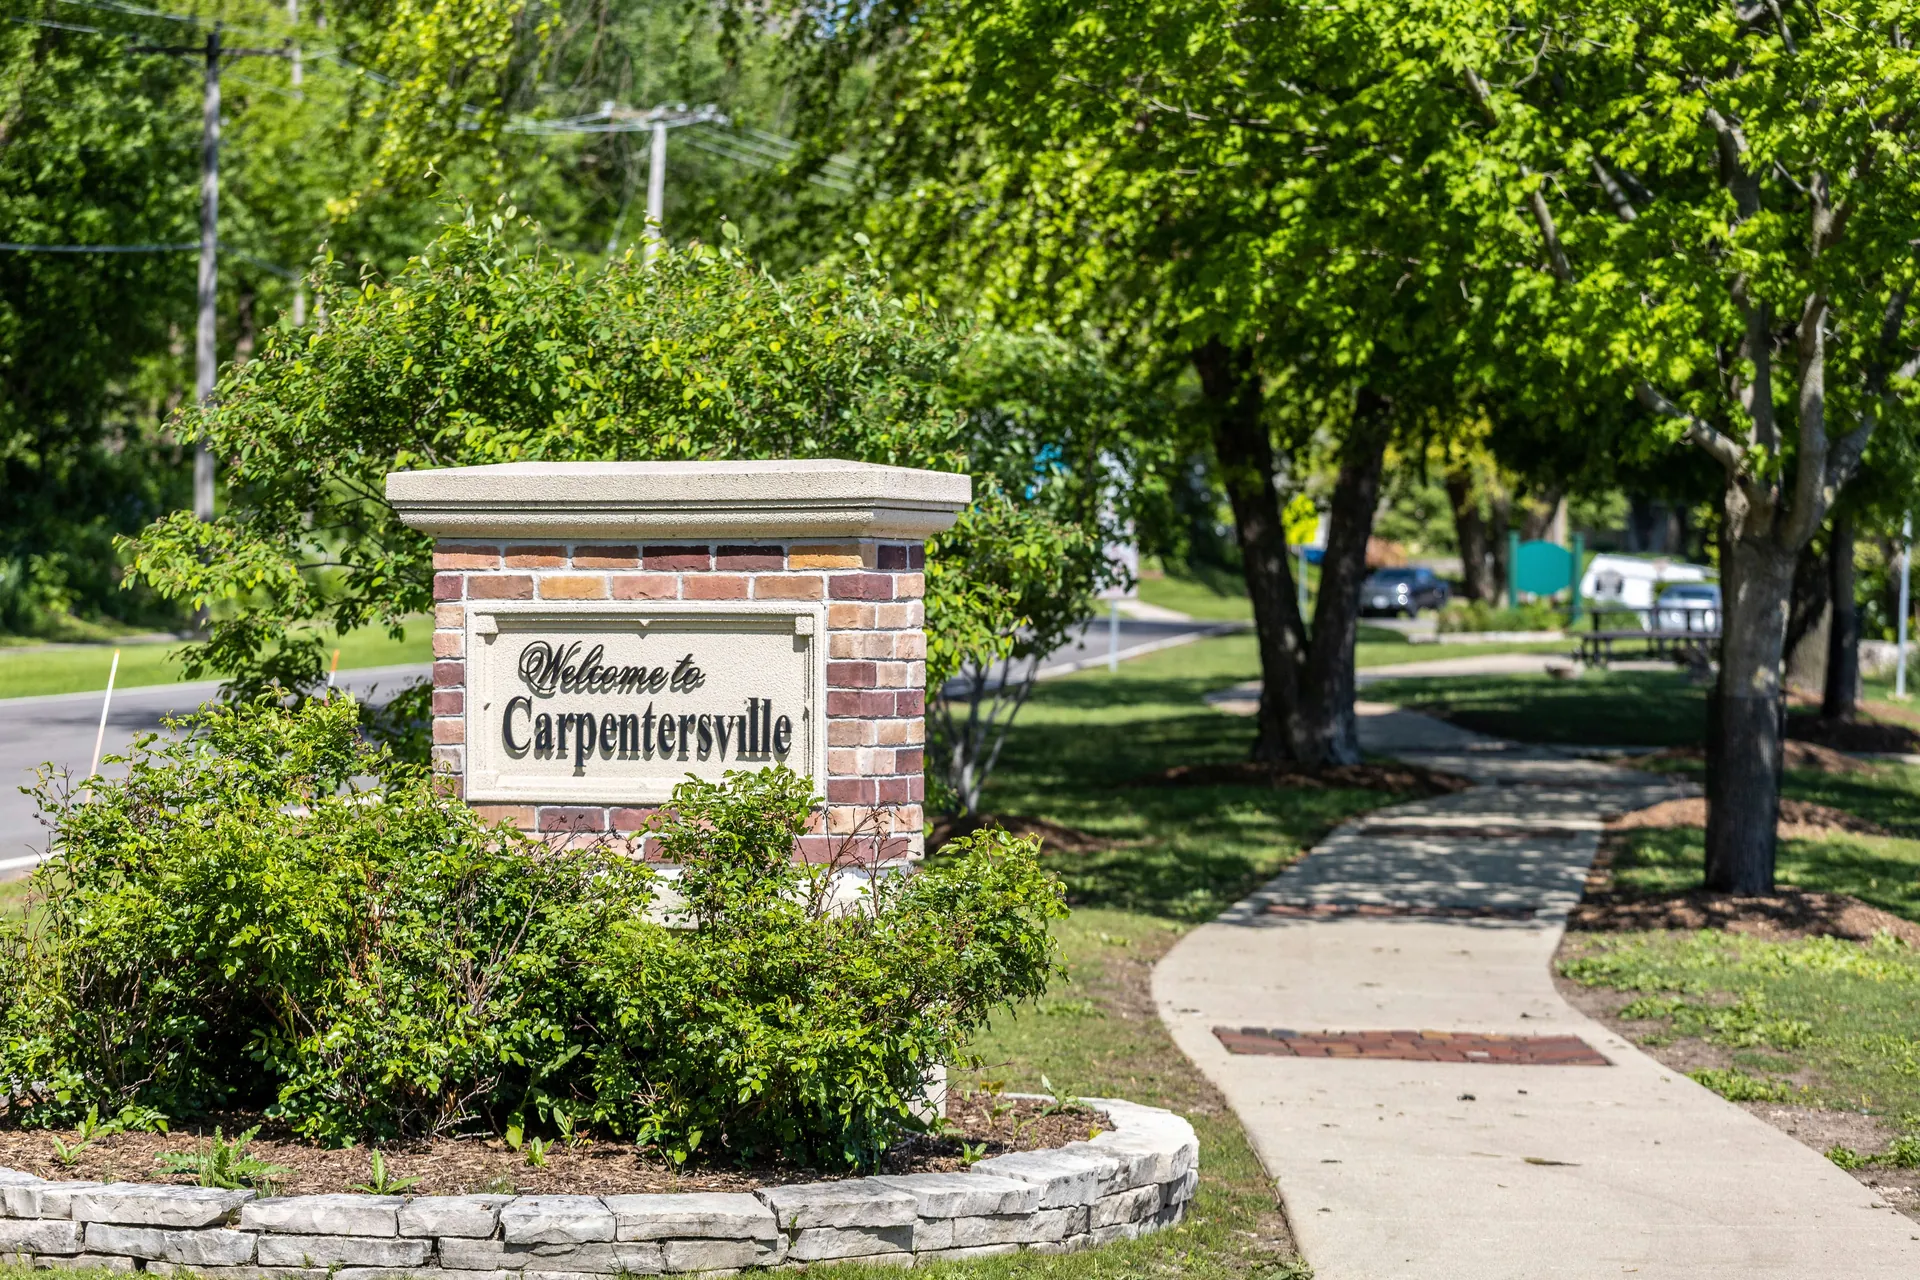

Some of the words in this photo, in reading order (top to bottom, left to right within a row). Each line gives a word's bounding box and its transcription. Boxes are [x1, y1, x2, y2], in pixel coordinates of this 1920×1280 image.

[518, 640, 669, 692] Welcome
[669, 653, 706, 686] to
[502, 695, 792, 768] Carpentersville
